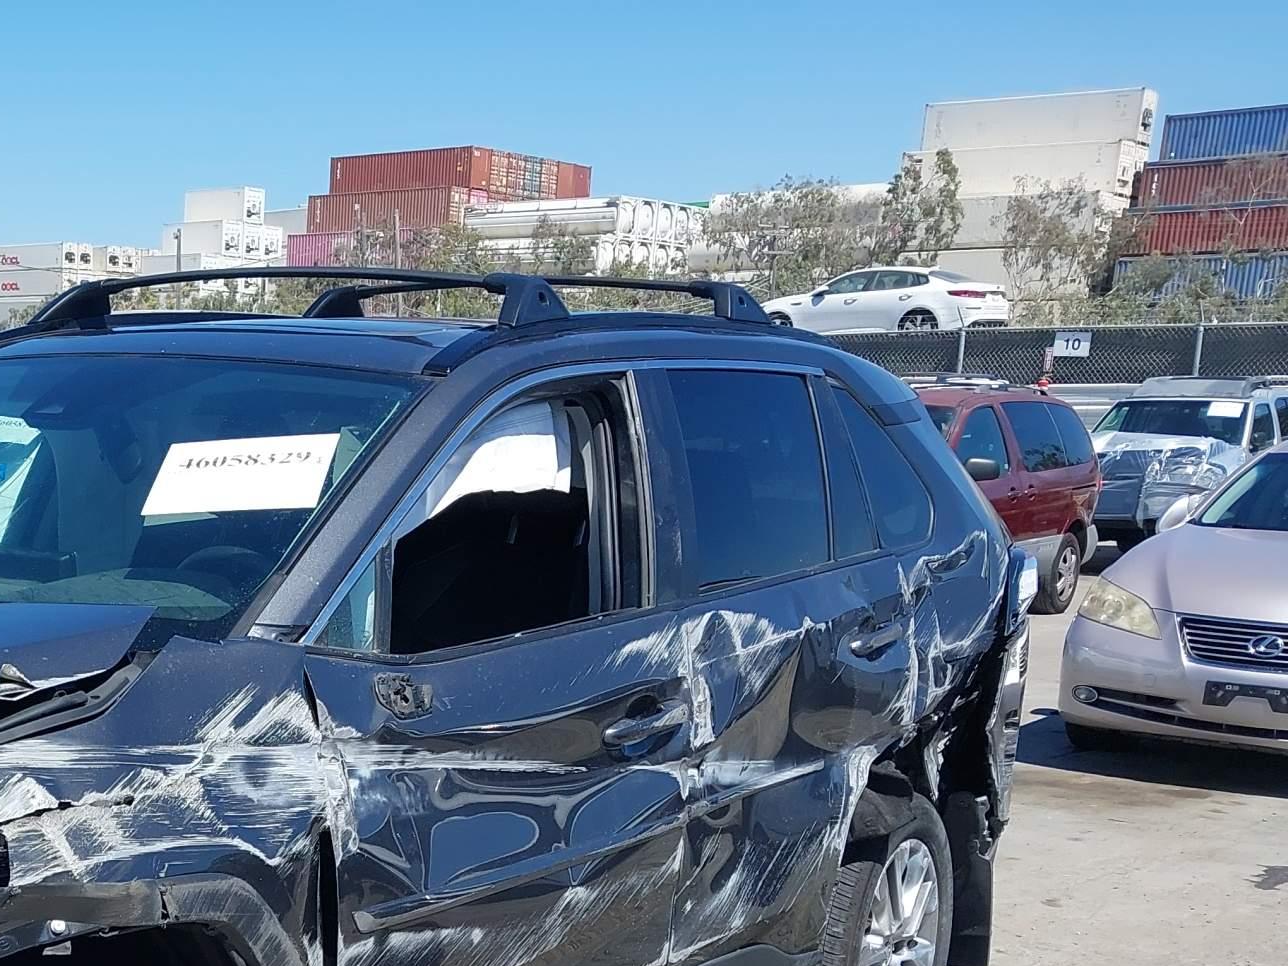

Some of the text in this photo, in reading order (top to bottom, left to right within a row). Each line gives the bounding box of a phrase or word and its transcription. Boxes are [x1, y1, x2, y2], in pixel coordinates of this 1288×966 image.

[1, 282, 20, 291] OOCL
[1063, 337, 1081, 351] 10
[178, 451, 312, 470] 46058329
